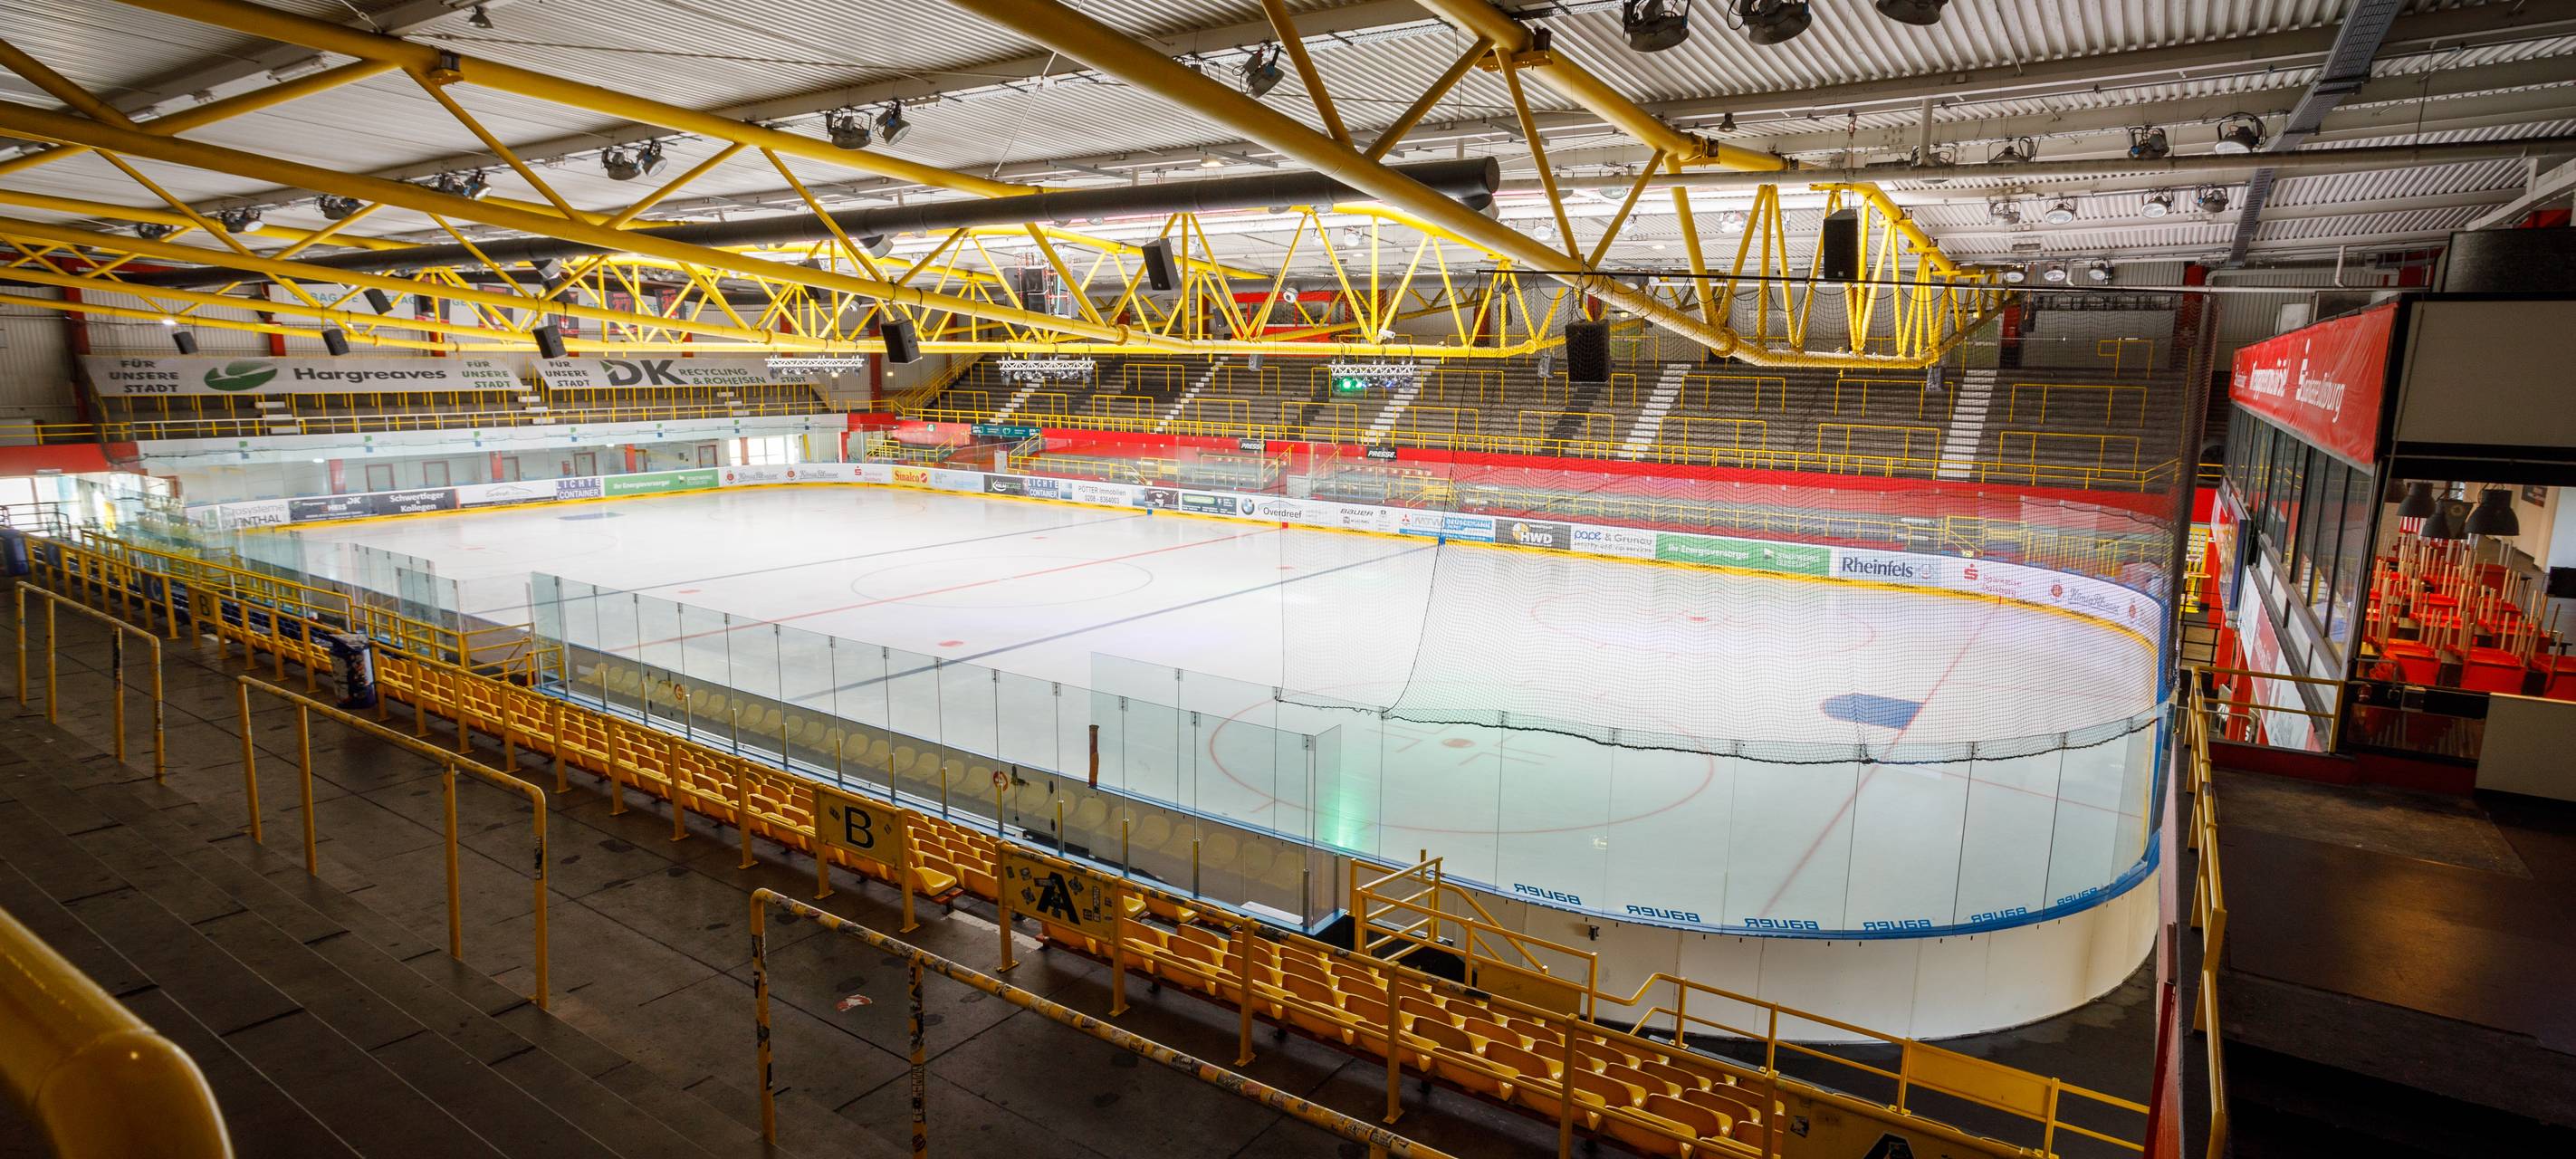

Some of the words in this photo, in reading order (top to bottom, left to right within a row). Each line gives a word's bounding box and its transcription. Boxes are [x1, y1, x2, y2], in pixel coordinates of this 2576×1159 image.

[120, 359, 156, 369] FÜR
[466, 360, 491, 369] FÜR
[549, 360, 571, 369] FÜR
[109, 371, 179, 380] UNSERE
[293, 368, 447, 383] Hargreaves
[545, 369, 589, 378] UNSERE
[599, 359, 688, 387] DK
[678, 368, 748, 377] RECYCLING
[474, 380, 512, 388] STADT
[557, 379, 590, 388] STADT
[693, 377, 703, 385] &
[704, 376, 766, 385] ROHEISEN
[123, 384, 178, 393] STADT
[895, 470, 920, 484] Sinalco
[556, 478, 601, 490] LICHTE
[1028, 478, 1058, 489] LICHTE
[389, 492, 445, 503] Schwertfeger
[559, 490, 599, 500] CONTAINER
[1029, 489, 1058, 498] CONTAINER
[400, 503, 436, 513] Kollegen
[1340, 508, 1374, 516] BAUER
[1263, 507, 1303, 520] Overdreef
[1520, 532, 1553, 544] HWD
[1614, 533, 1652, 546] Grunau
[1842, 556, 1913, 579] Rheinfels
[199, 593, 211, 617] B
[844, 805, 875, 849] B
[1037, 871, 1081, 925] A
